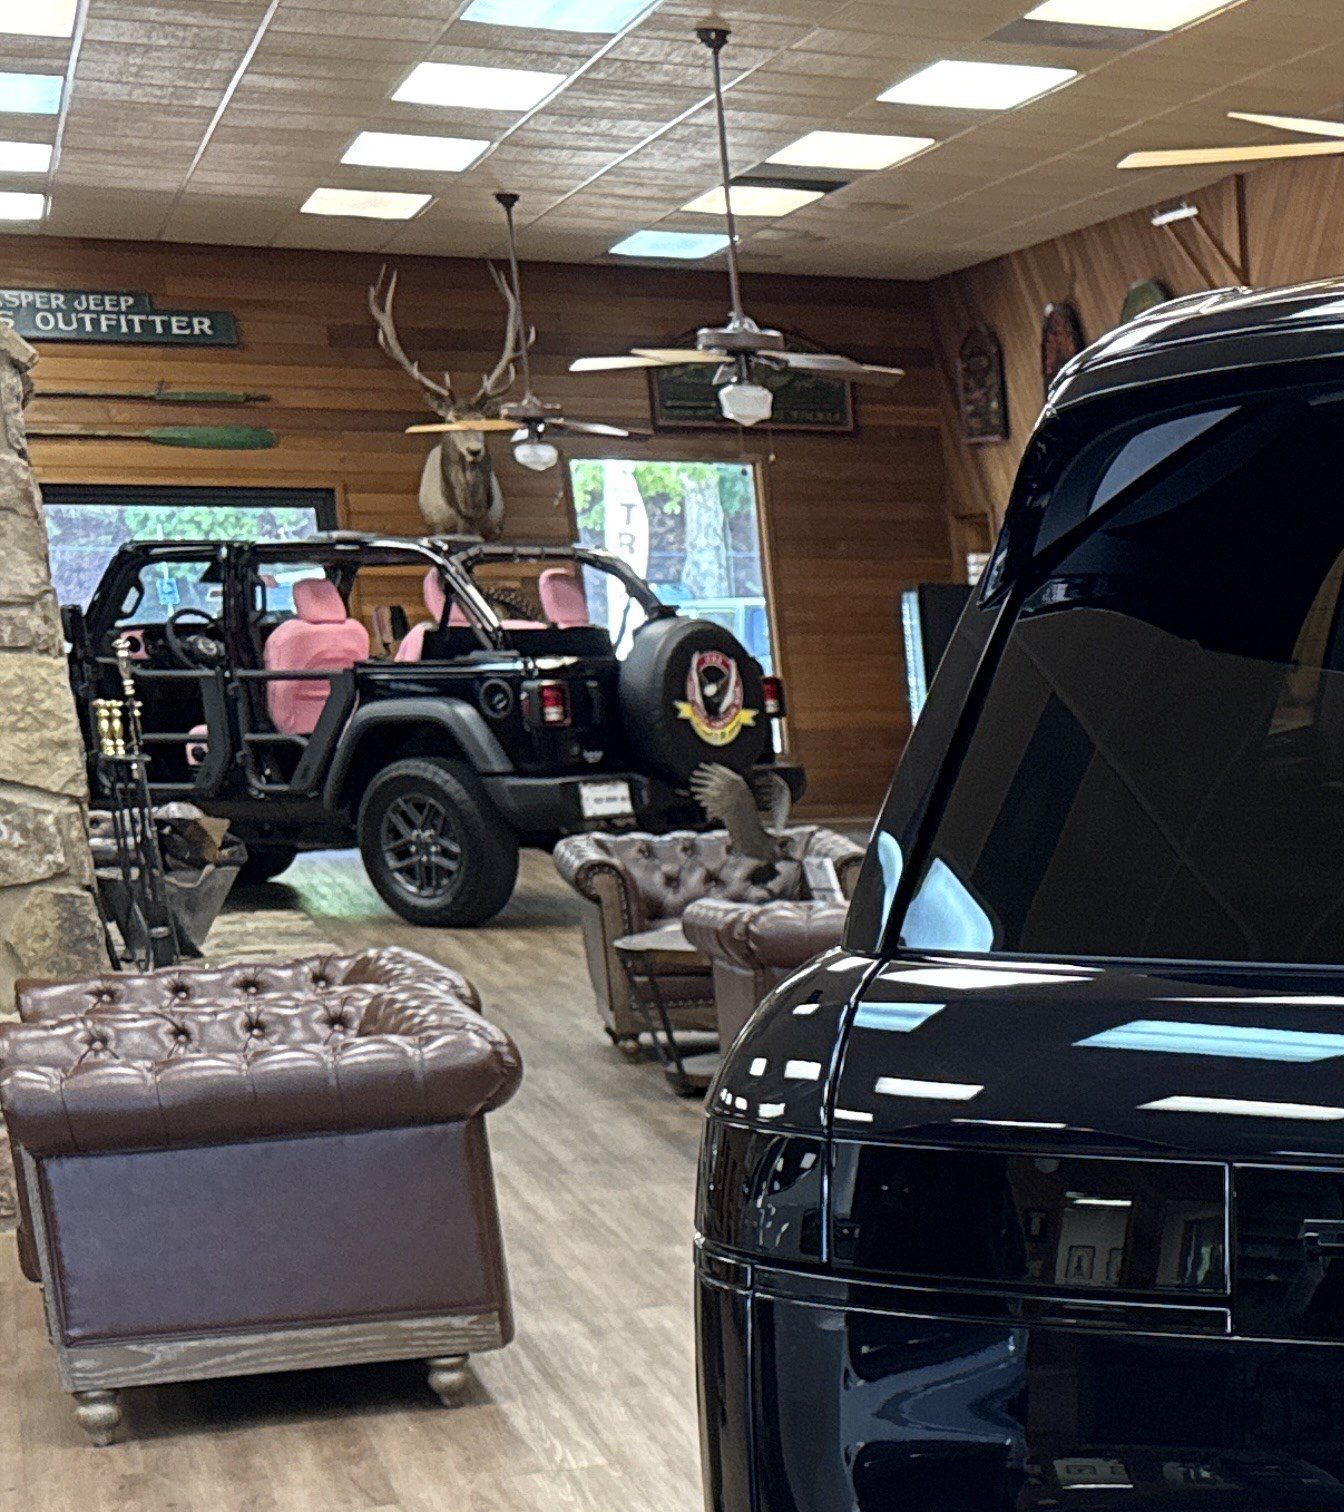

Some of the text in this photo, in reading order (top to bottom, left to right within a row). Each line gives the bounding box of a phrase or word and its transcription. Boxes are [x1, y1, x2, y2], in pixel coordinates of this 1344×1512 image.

[0, 291, 135, 312] SPER JEEP
[35, 311, 214, 336] OUTFITTER
